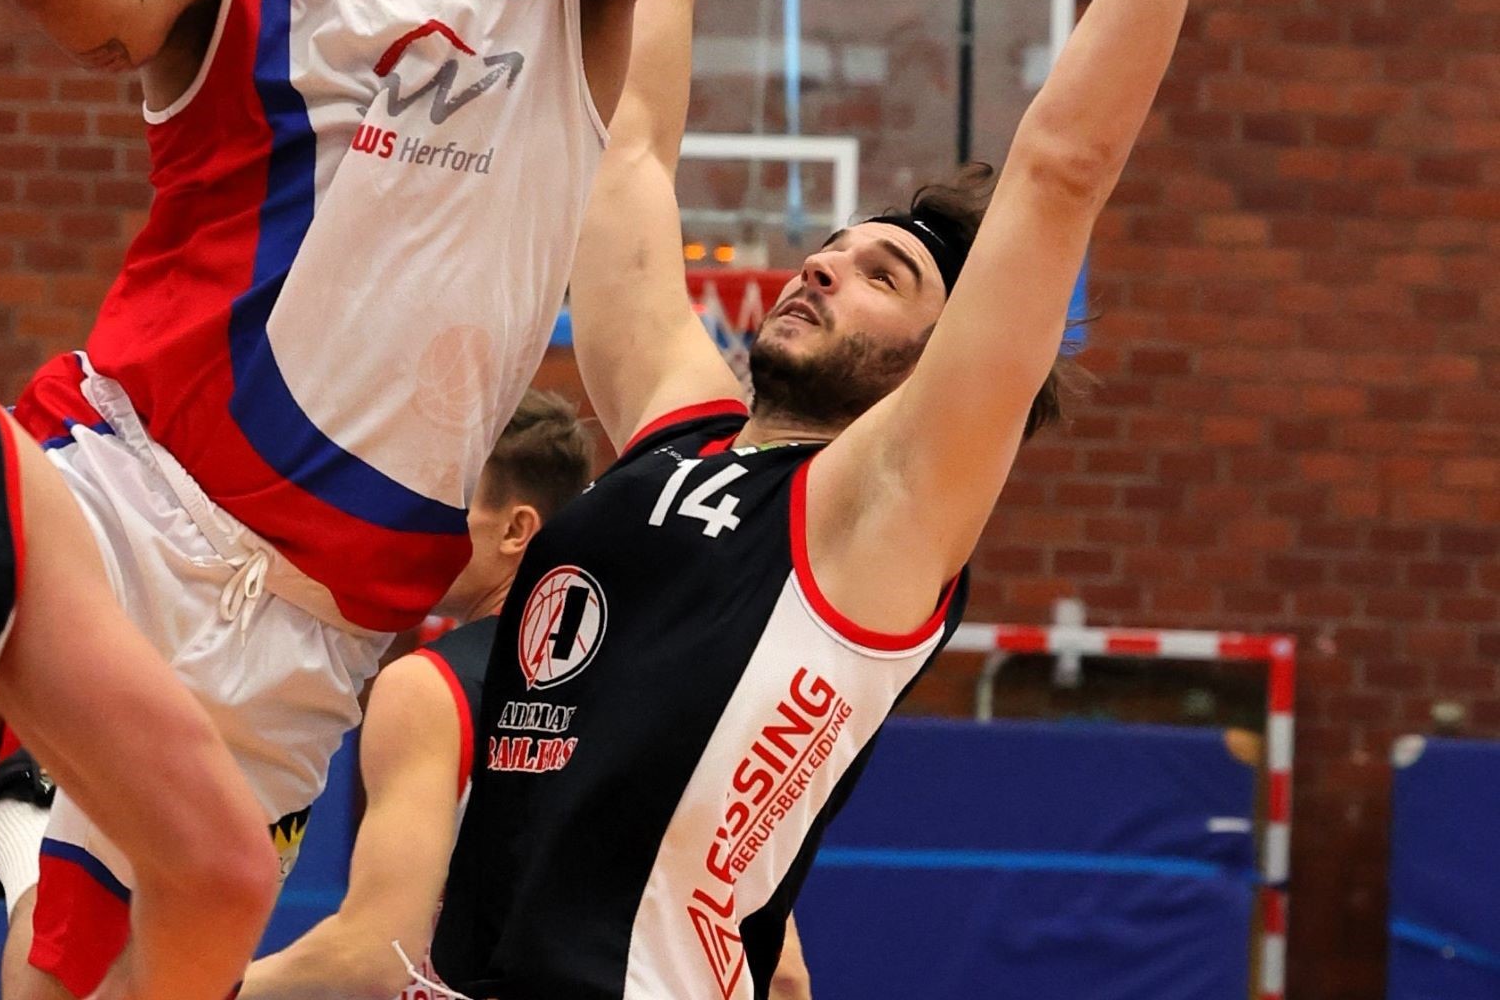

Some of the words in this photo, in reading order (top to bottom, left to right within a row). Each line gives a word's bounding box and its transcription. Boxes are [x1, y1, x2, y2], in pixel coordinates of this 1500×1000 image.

[352, 124, 398, 159] WS
[398, 137, 494, 174] Herford
[648, 458, 749, 538] 14
[731, 701, 853, 874] BERUFSBEKLEIDUNG
